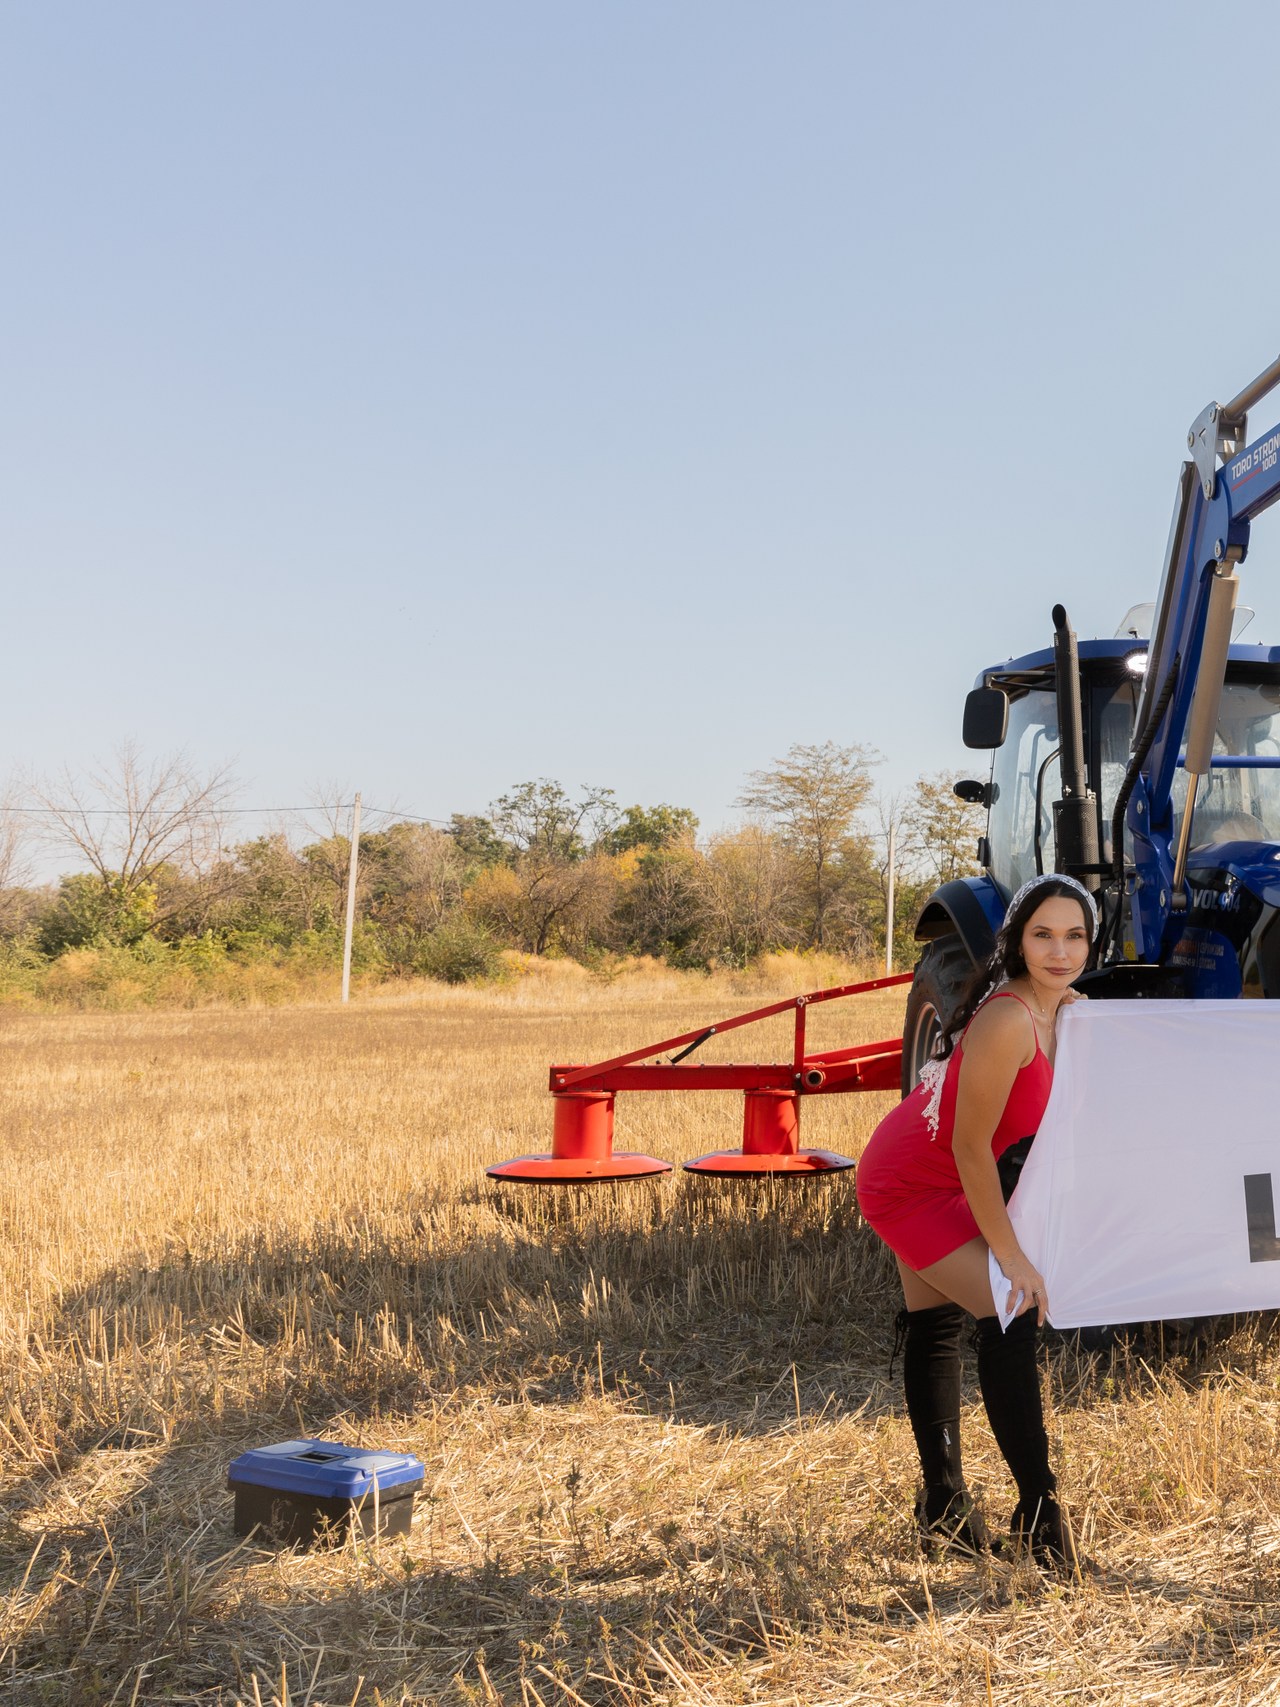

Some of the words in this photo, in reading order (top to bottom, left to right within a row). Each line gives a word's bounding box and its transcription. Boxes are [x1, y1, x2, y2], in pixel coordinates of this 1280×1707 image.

[1231, 454, 1252, 480] TORO
[1262, 452, 1277, 472] 1000
[1193, 888, 1219, 910] VOL
